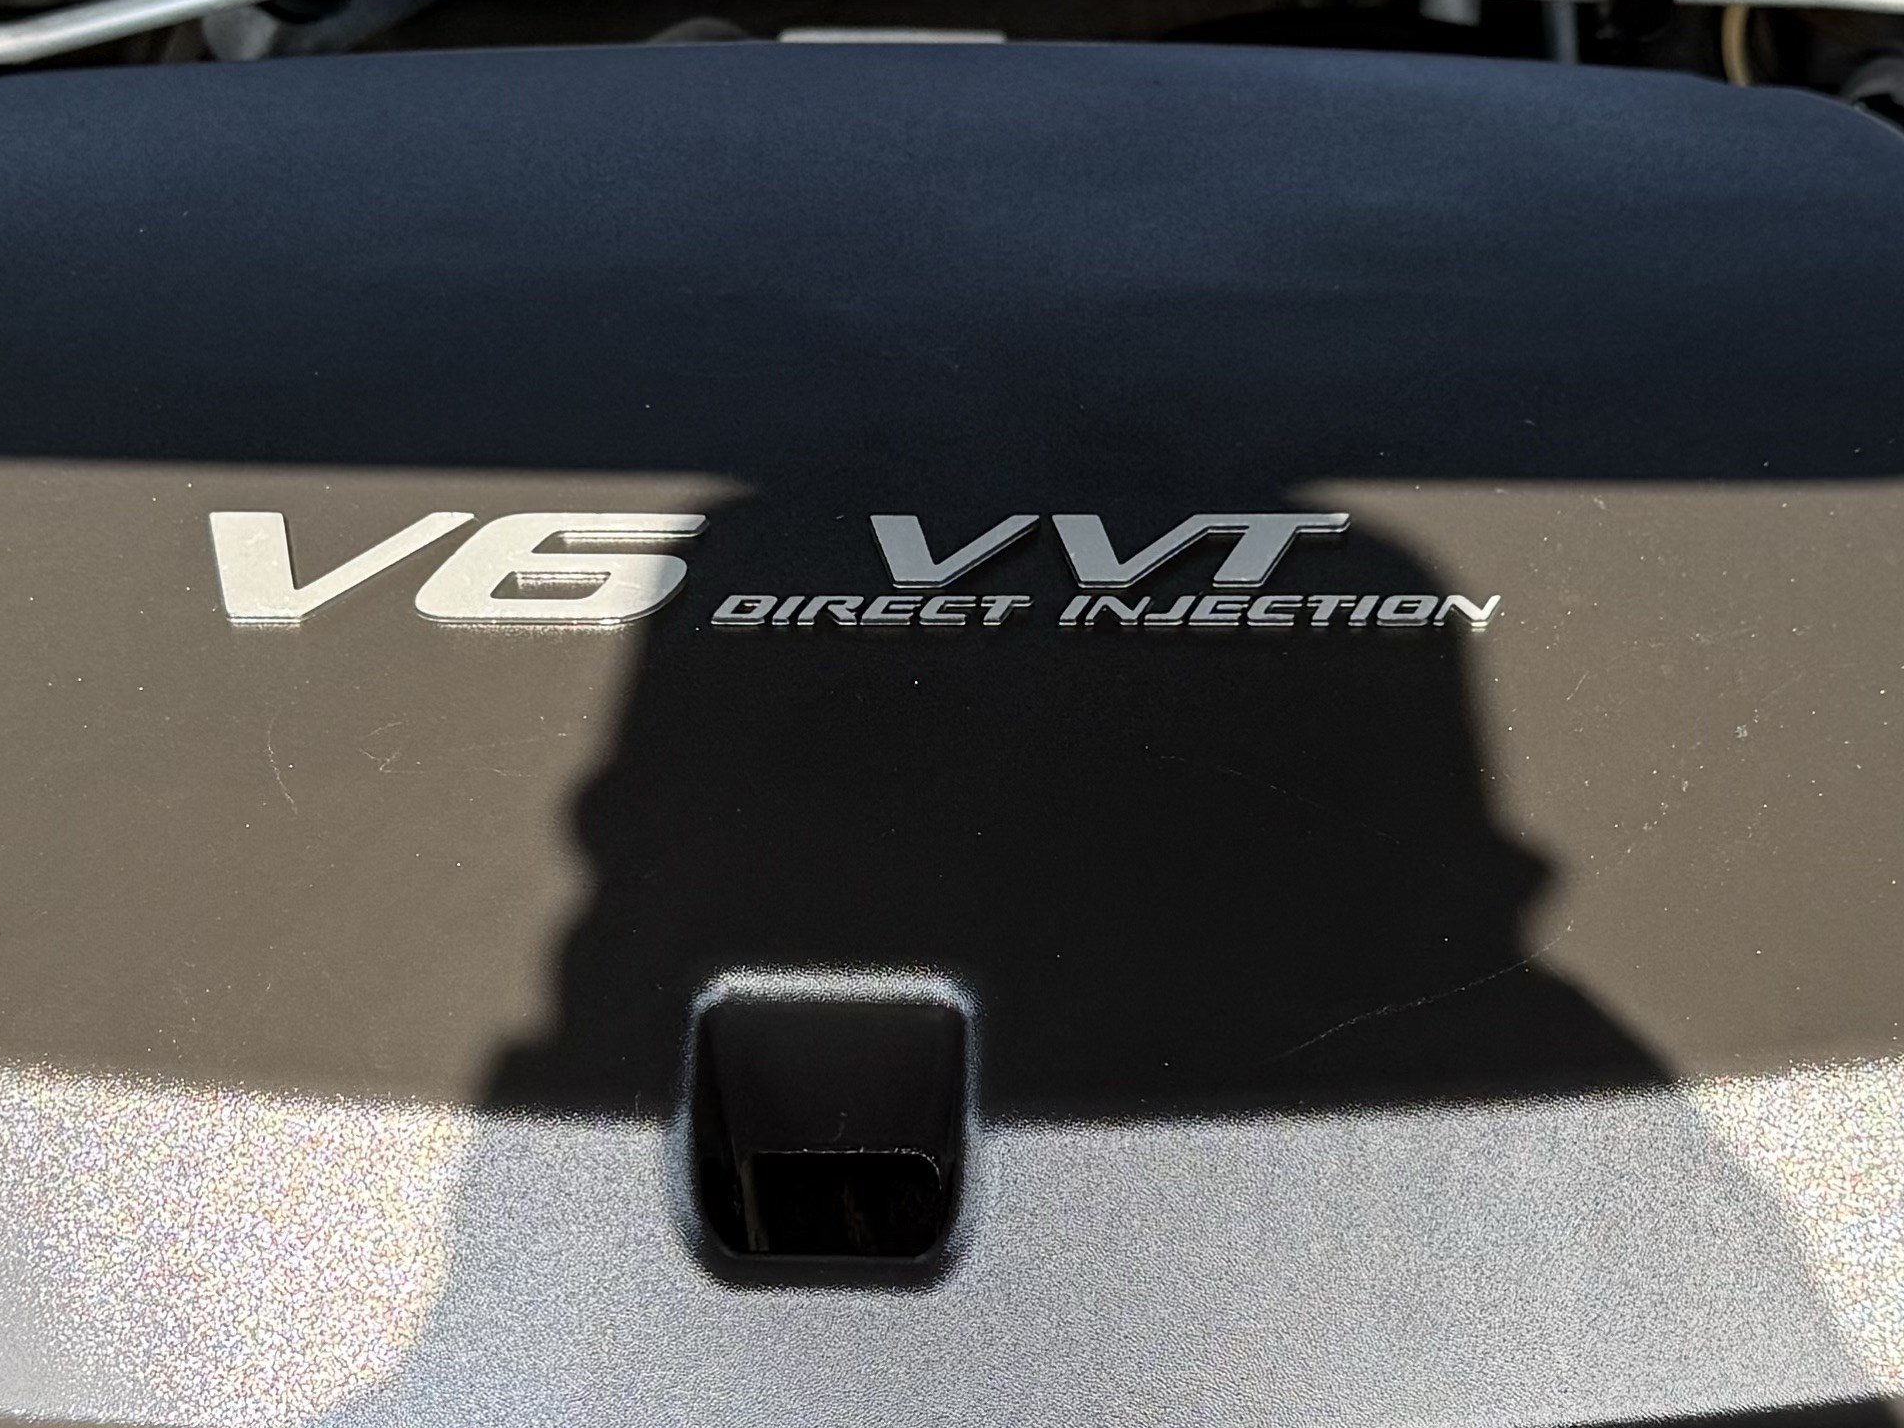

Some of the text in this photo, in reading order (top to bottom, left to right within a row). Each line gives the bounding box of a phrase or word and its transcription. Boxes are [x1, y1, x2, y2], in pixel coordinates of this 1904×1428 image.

[207, 510, 1351, 626] V6 VVT
[710, 592, 1502, 627] DIRECT INJECTION
